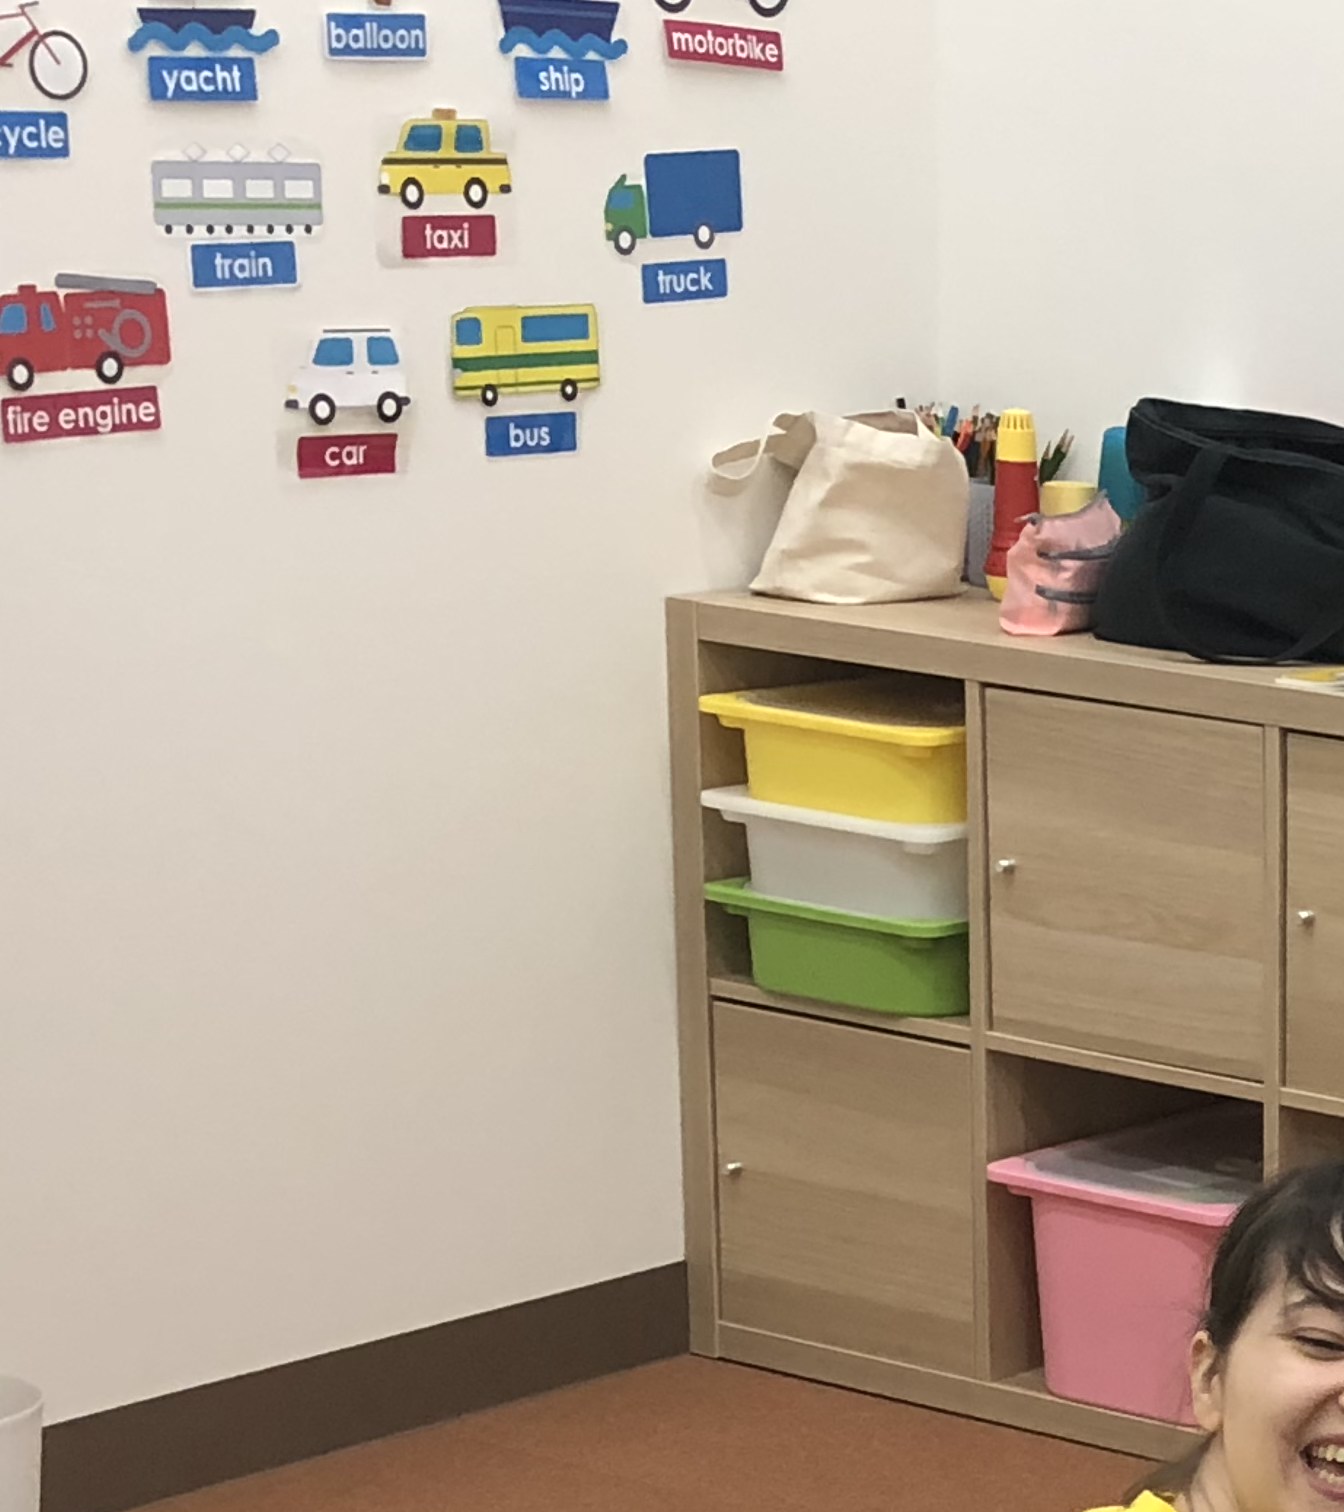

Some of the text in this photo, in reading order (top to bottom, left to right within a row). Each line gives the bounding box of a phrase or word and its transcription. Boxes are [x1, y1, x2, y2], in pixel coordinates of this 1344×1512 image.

[329, 22, 425, 50] balloon
[671, 30, 780, 62] motorbike
[162, 64, 241, 98] yacht
[538, 65, 585, 98] ship
[0, 119, 65, 155] ycle
[424, 222, 470, 250] taxi
[214, 250, 273, 280] train
[657, 267, 714, 294] truck
[7, 397, 156, 435] fire engine
[508, 422, 551, 449] bus
[324, 441, 367, 468] car
